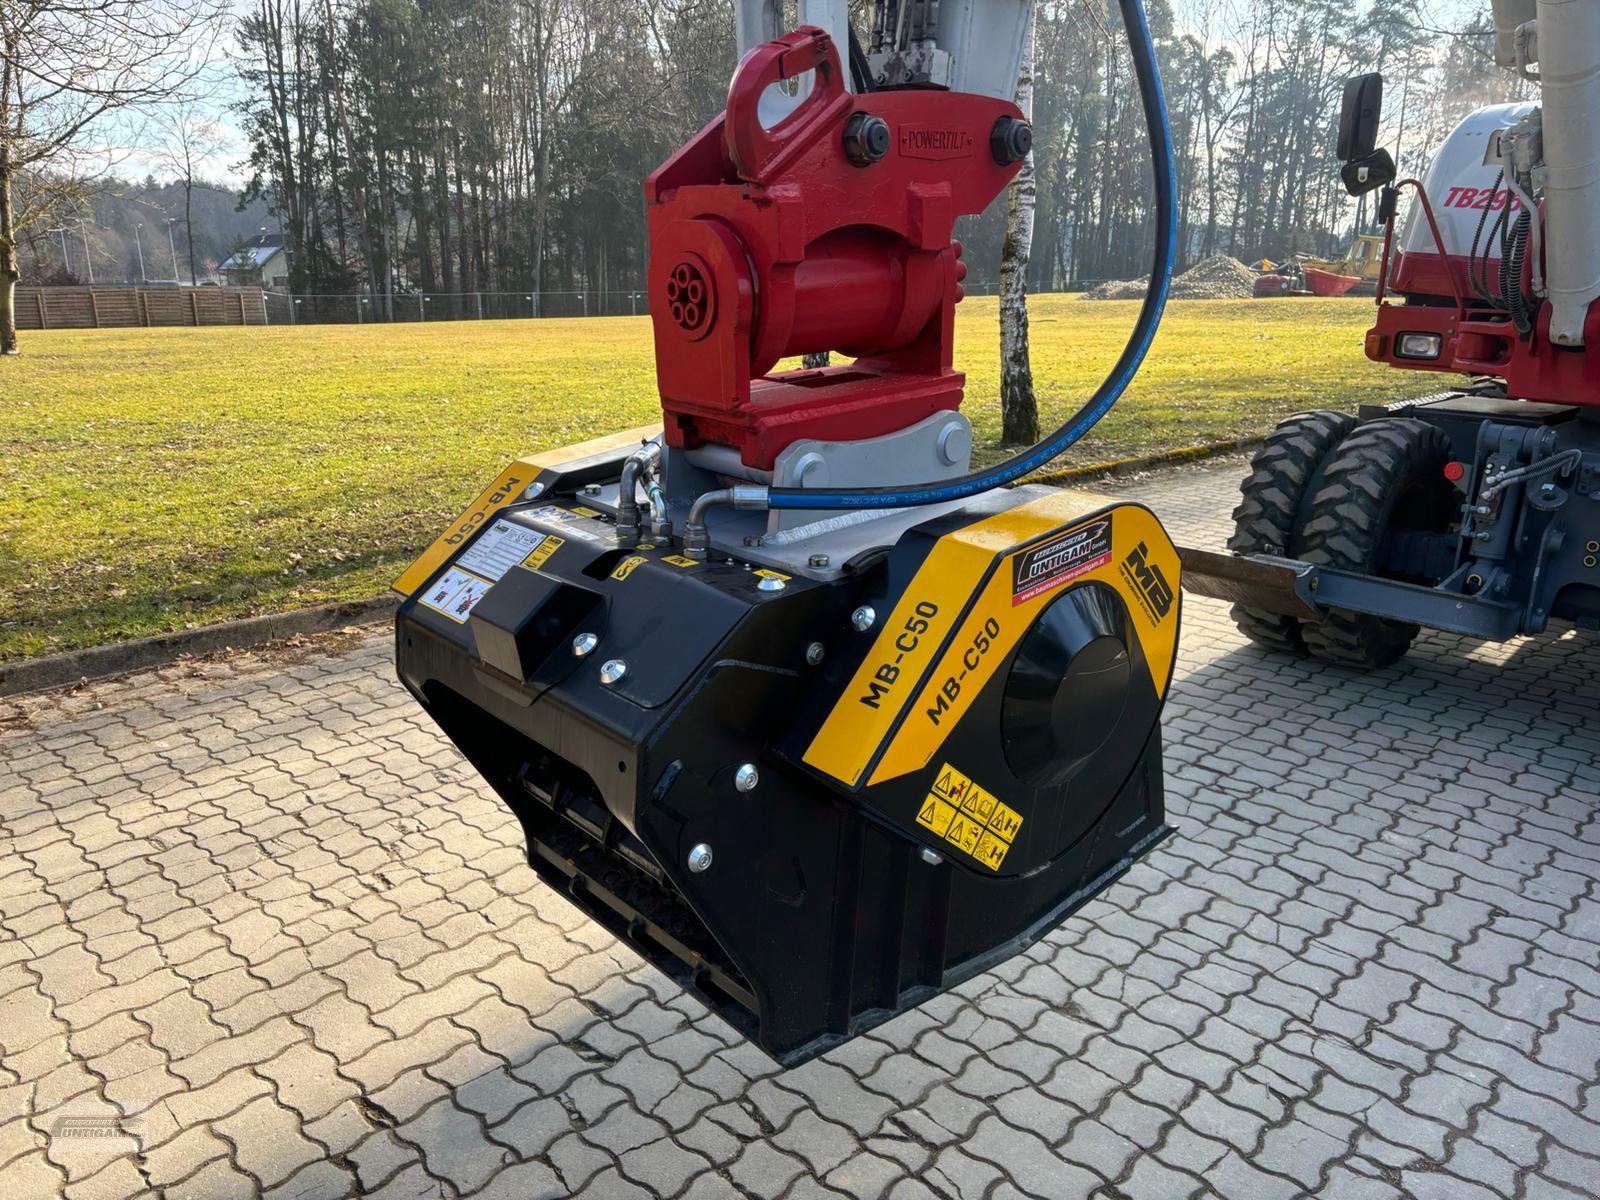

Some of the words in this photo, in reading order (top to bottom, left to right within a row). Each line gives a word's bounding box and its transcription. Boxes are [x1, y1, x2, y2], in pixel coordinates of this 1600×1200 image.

[908, 130, 967, 149] POWERTILT
[445, 477, 520, 545] MB-C50
[859, 601, 939, 710] MB-C50
[926, 617, 1000, 726] MB-C50
